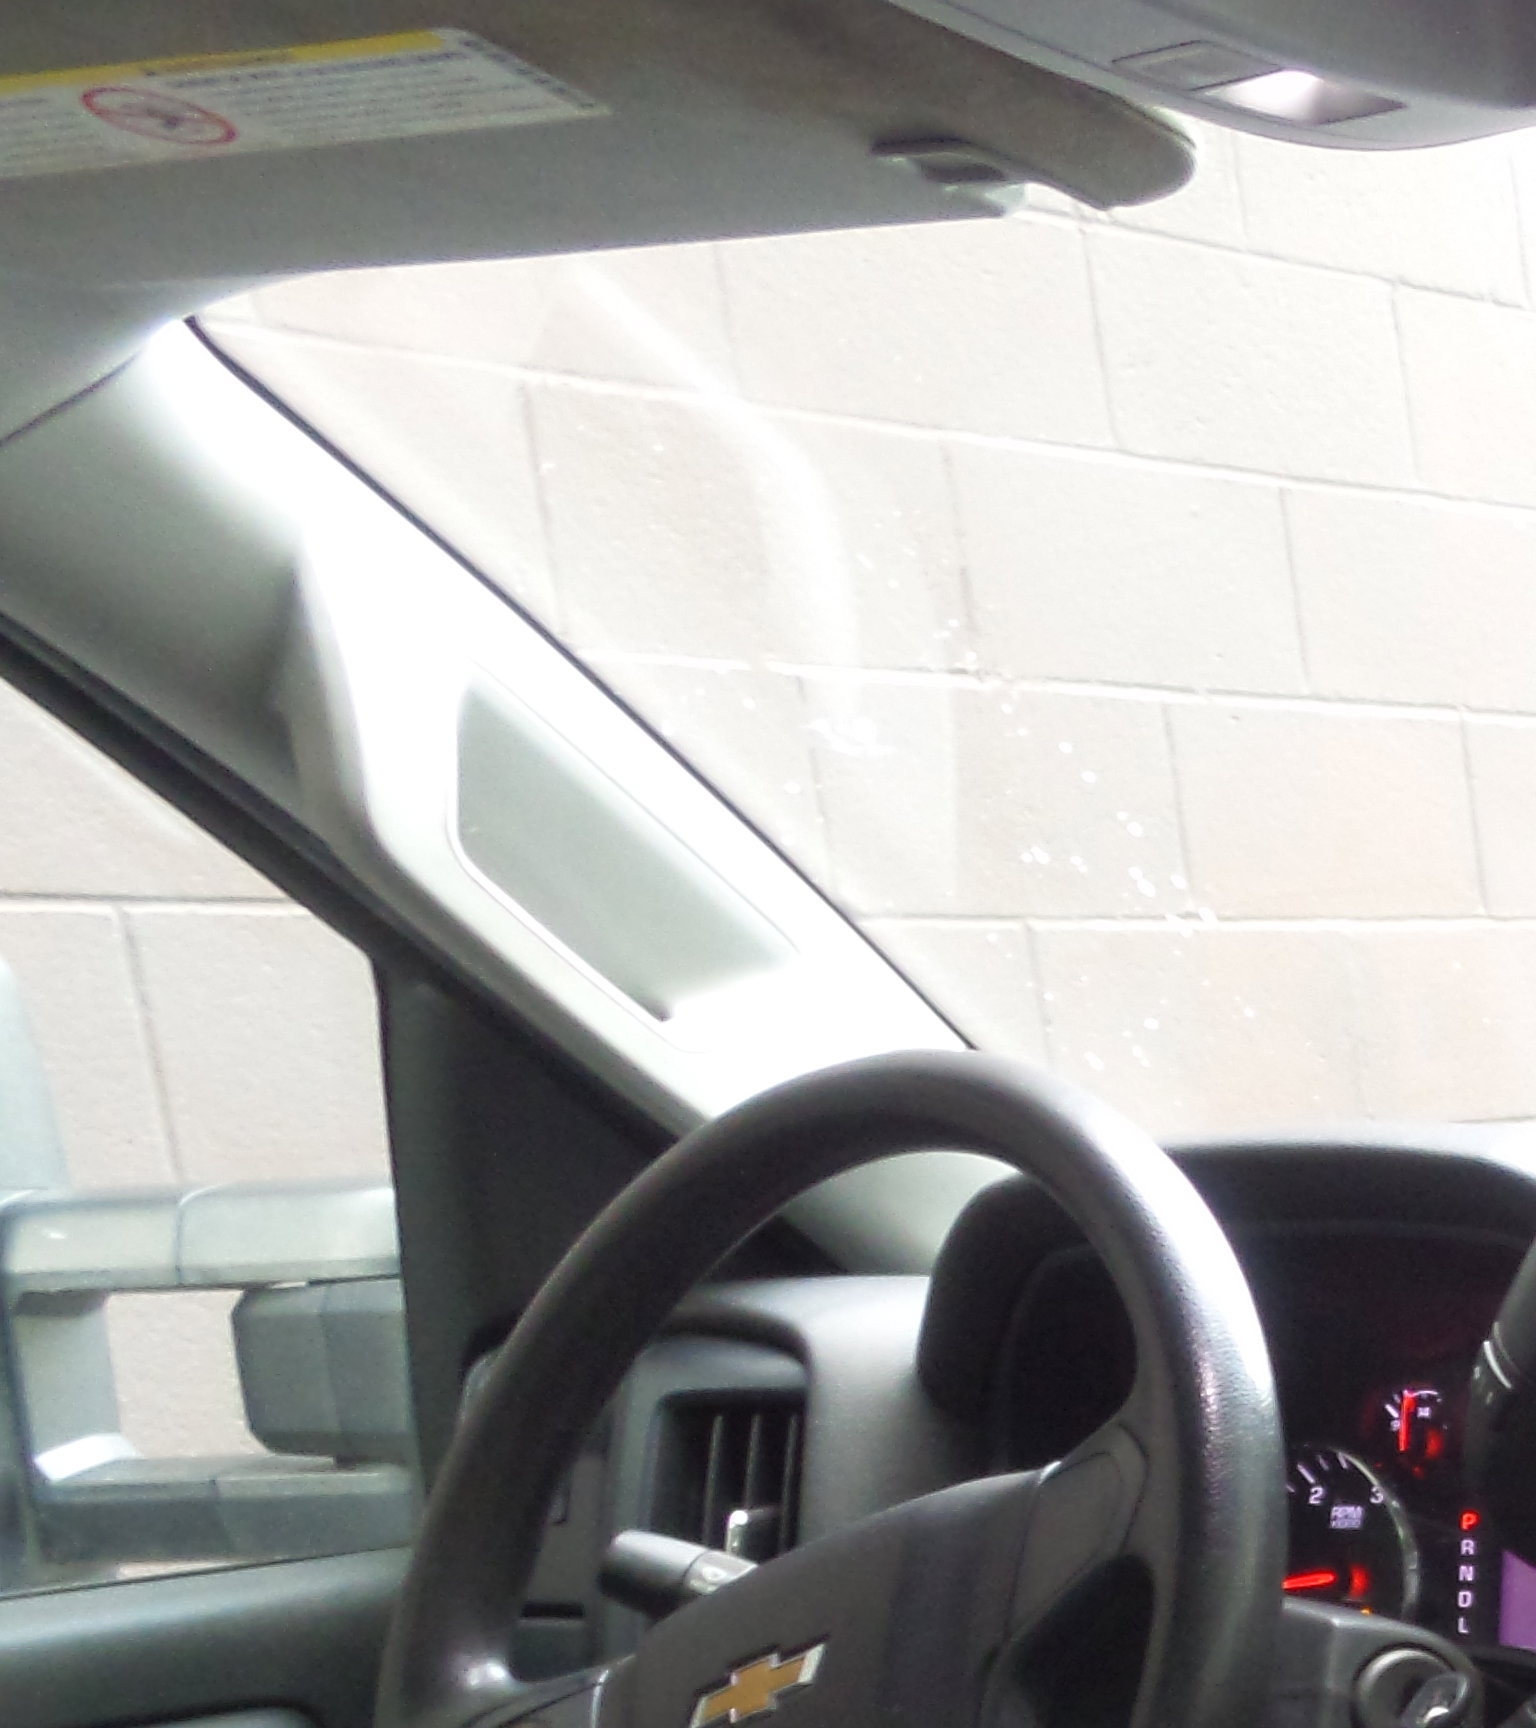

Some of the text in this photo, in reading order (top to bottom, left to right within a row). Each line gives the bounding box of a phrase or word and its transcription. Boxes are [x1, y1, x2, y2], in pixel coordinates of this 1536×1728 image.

[1309, 1486, 1324, 1504] 2
[1462, 1511, 1479, 1530] P
[1460, 1539, 1475, 1555] R
[1458, 1565, 1474, 1582] N
[1457, 1590, 1473, 1608] D
[1457, 1617, 1469, 1634] L
